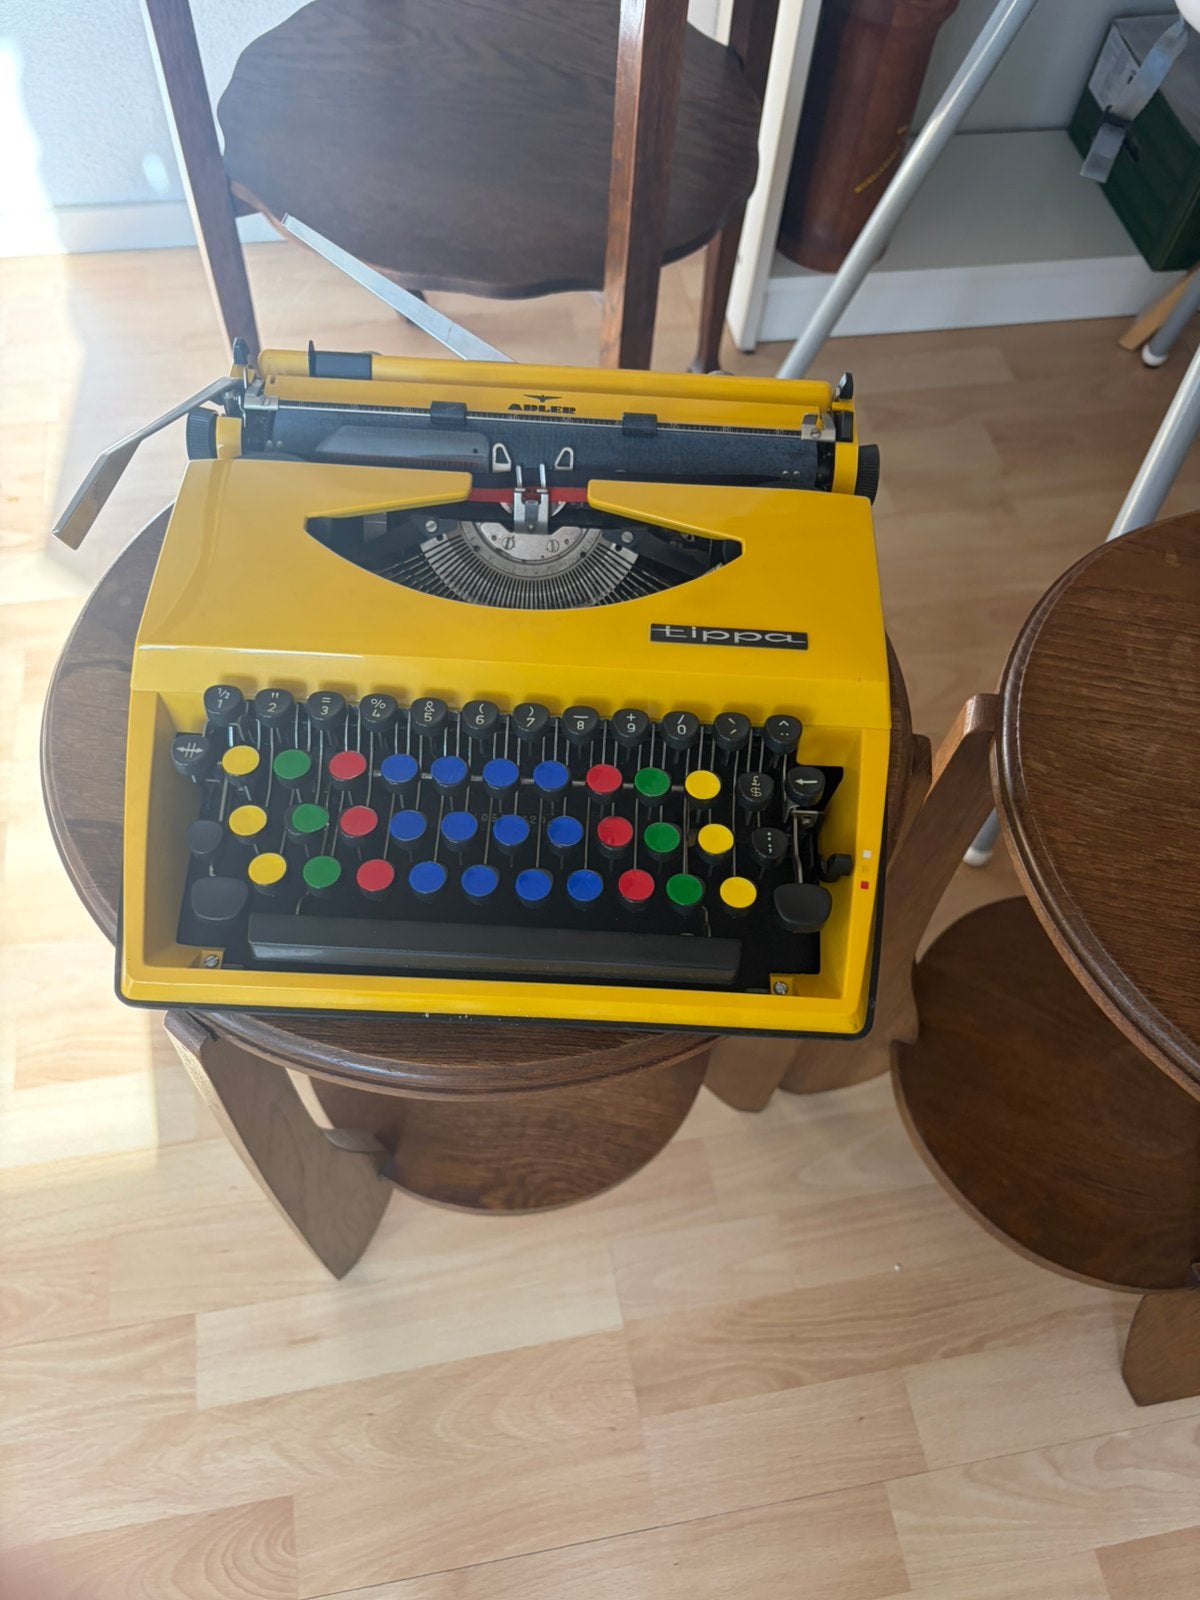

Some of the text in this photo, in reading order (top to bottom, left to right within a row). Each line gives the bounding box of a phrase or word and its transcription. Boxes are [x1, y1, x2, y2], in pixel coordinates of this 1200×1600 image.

[508, 403, 577, 415] ADLER
[651, 625, 806, 644] tippa
[267, 702, 277, 713] 2
[370, 698, 386, 709] %
[425, 701, 435, 712] &
[321, 705, 330, 716] 3
[372, 708, 381, 718] 4
[424, 712, 433, 722] 5
[475, 714, 485, 725] 6
[526, 717, 536, 727] 7
[626, 713, 637, 722] +
[576, 720, 585, 730] 8
[627, 722, 636, 733] 9
[750, 786, 763, 798] $
